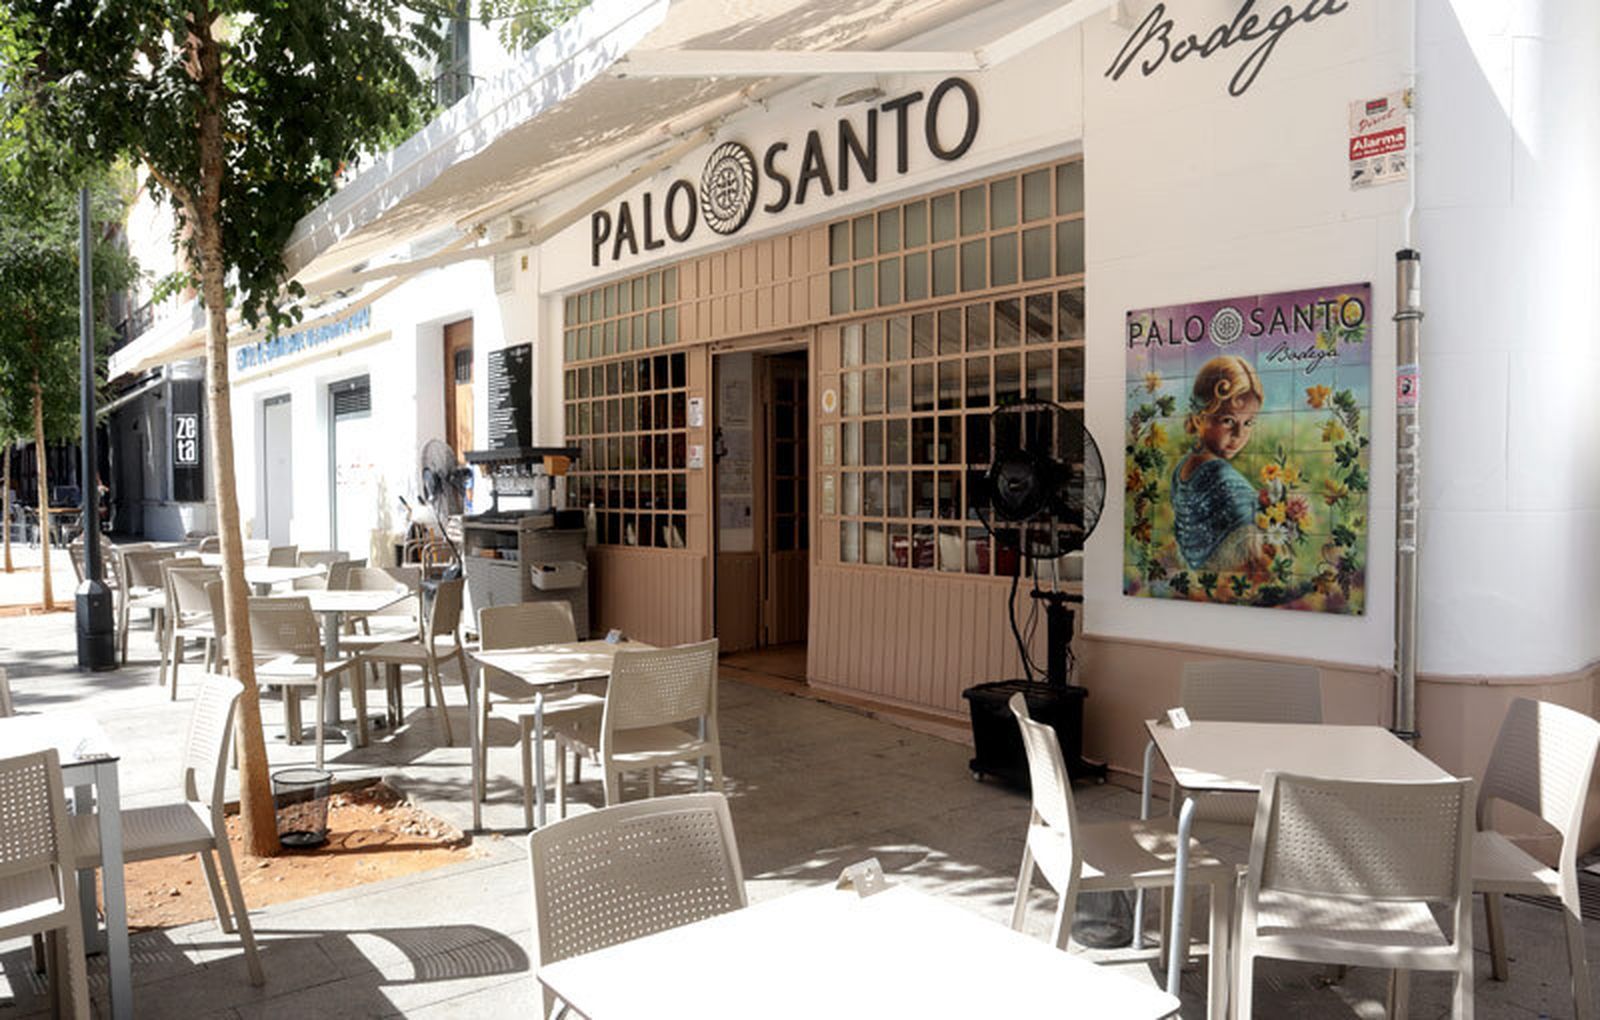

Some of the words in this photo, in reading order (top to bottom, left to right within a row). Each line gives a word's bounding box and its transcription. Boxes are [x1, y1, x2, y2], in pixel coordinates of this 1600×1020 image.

[1104, 0, 1349, 97] Bodega
[1352, 132, 1405, 152] Alarma
[591, 180, 698, 267] PALO
[763, 76, 980, 214] SANTO
[1128, 314, 1205, 350] PALO
[1249, 297, 1366, 338] SANTO
[1266, 340, 1340, 375] Bodega
